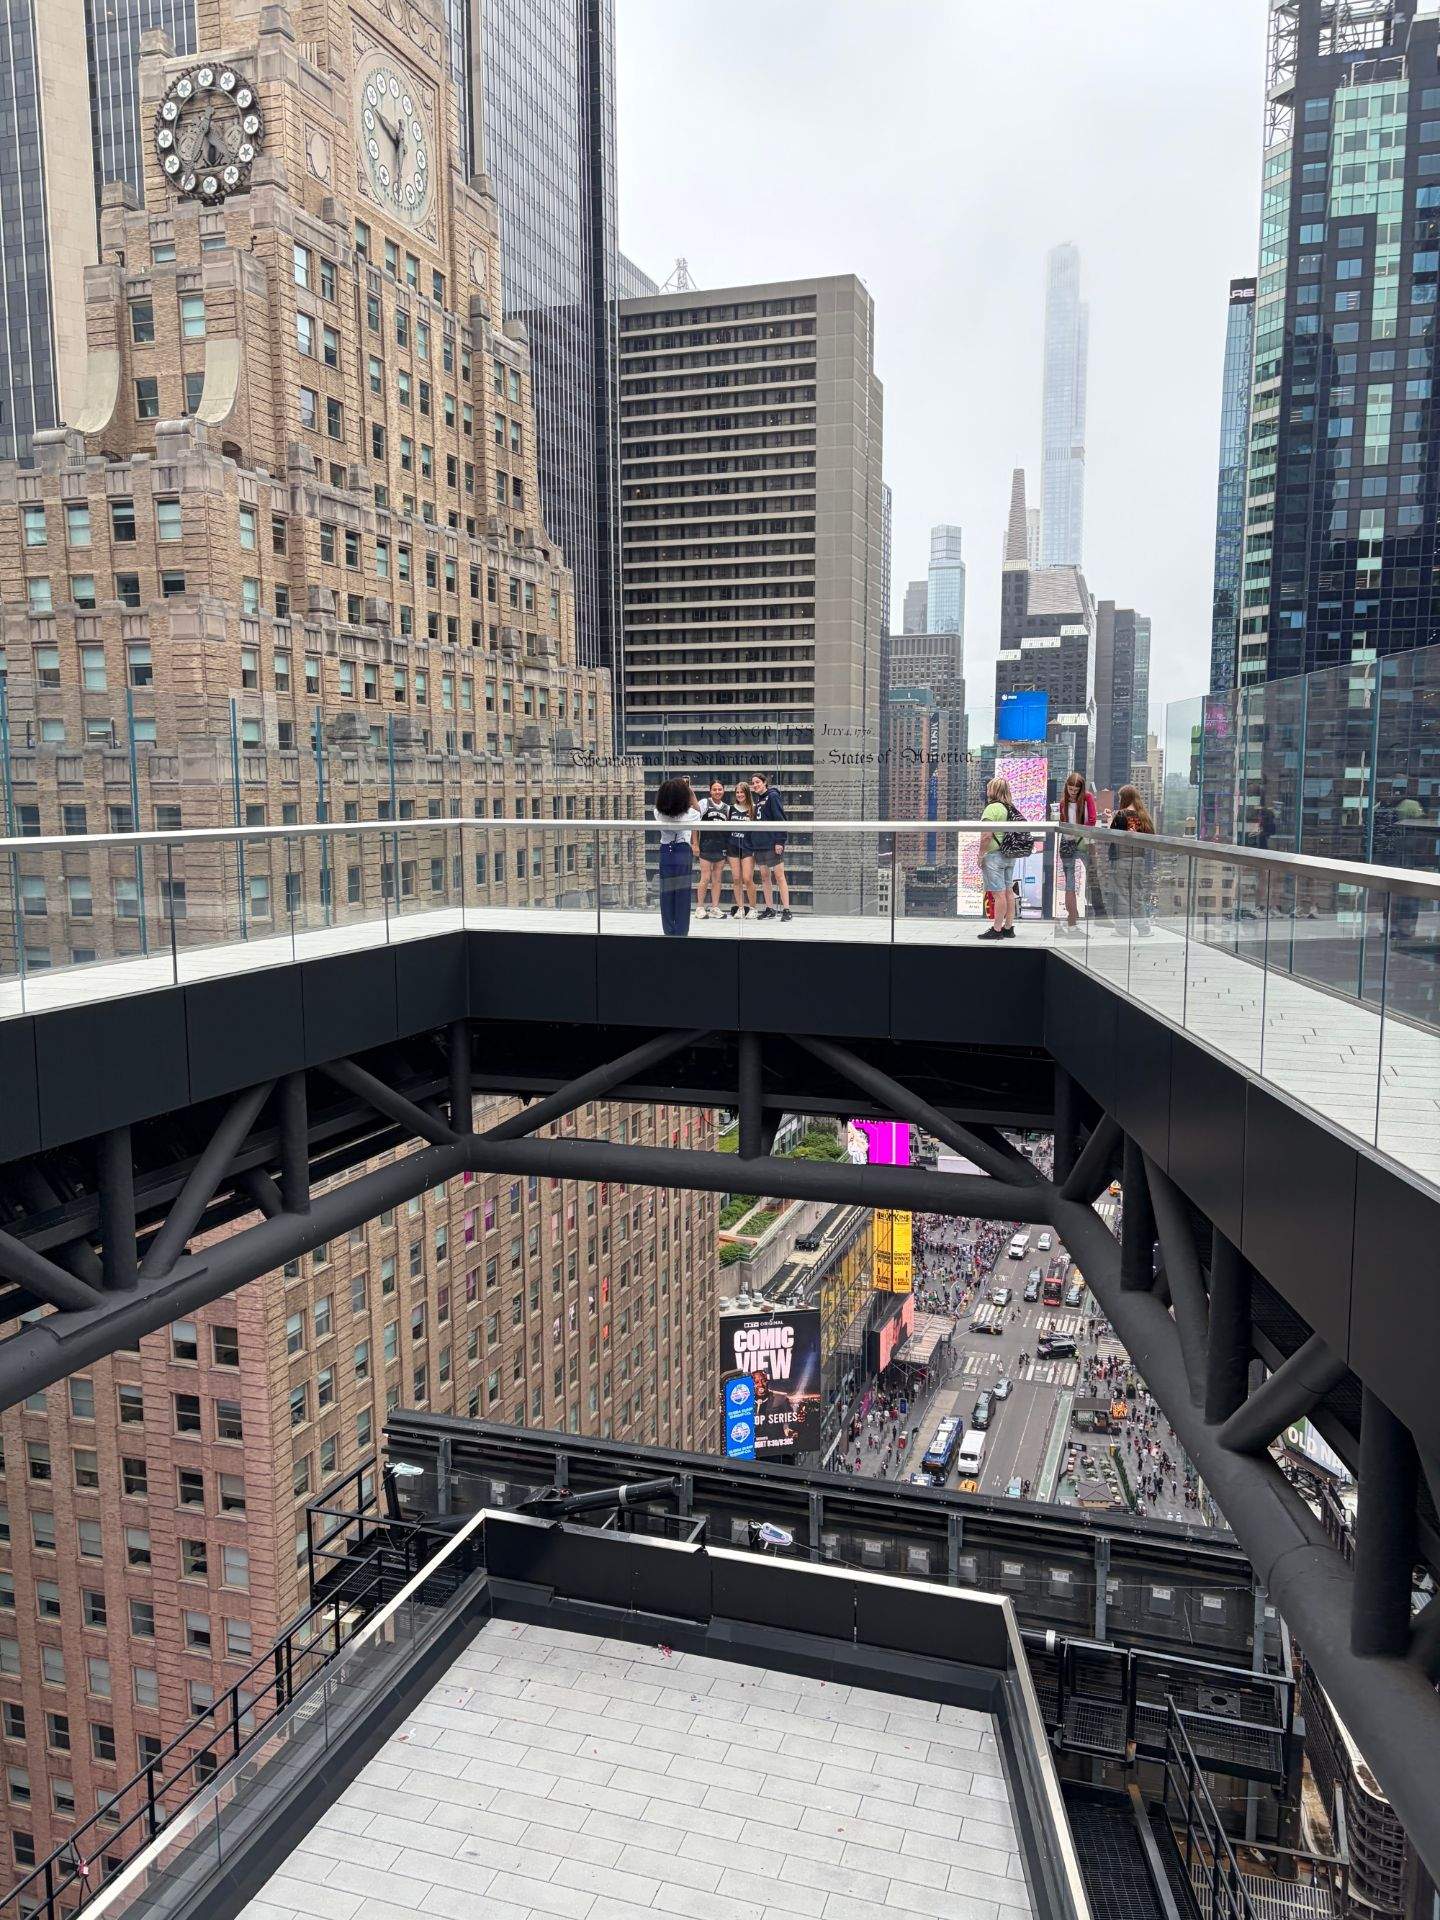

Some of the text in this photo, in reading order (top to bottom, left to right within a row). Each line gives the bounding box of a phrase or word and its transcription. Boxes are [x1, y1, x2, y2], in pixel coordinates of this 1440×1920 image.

[829, 749, 874, 764] States
[878, 748, 892, 764] of
[733, 1326, 794, 1352] COMIC
[735, 1348, 792, 1380] VIEW
[768, 1412, 798, 1424] SERIES
[1287, 1426, 1317, 1455] OLD
